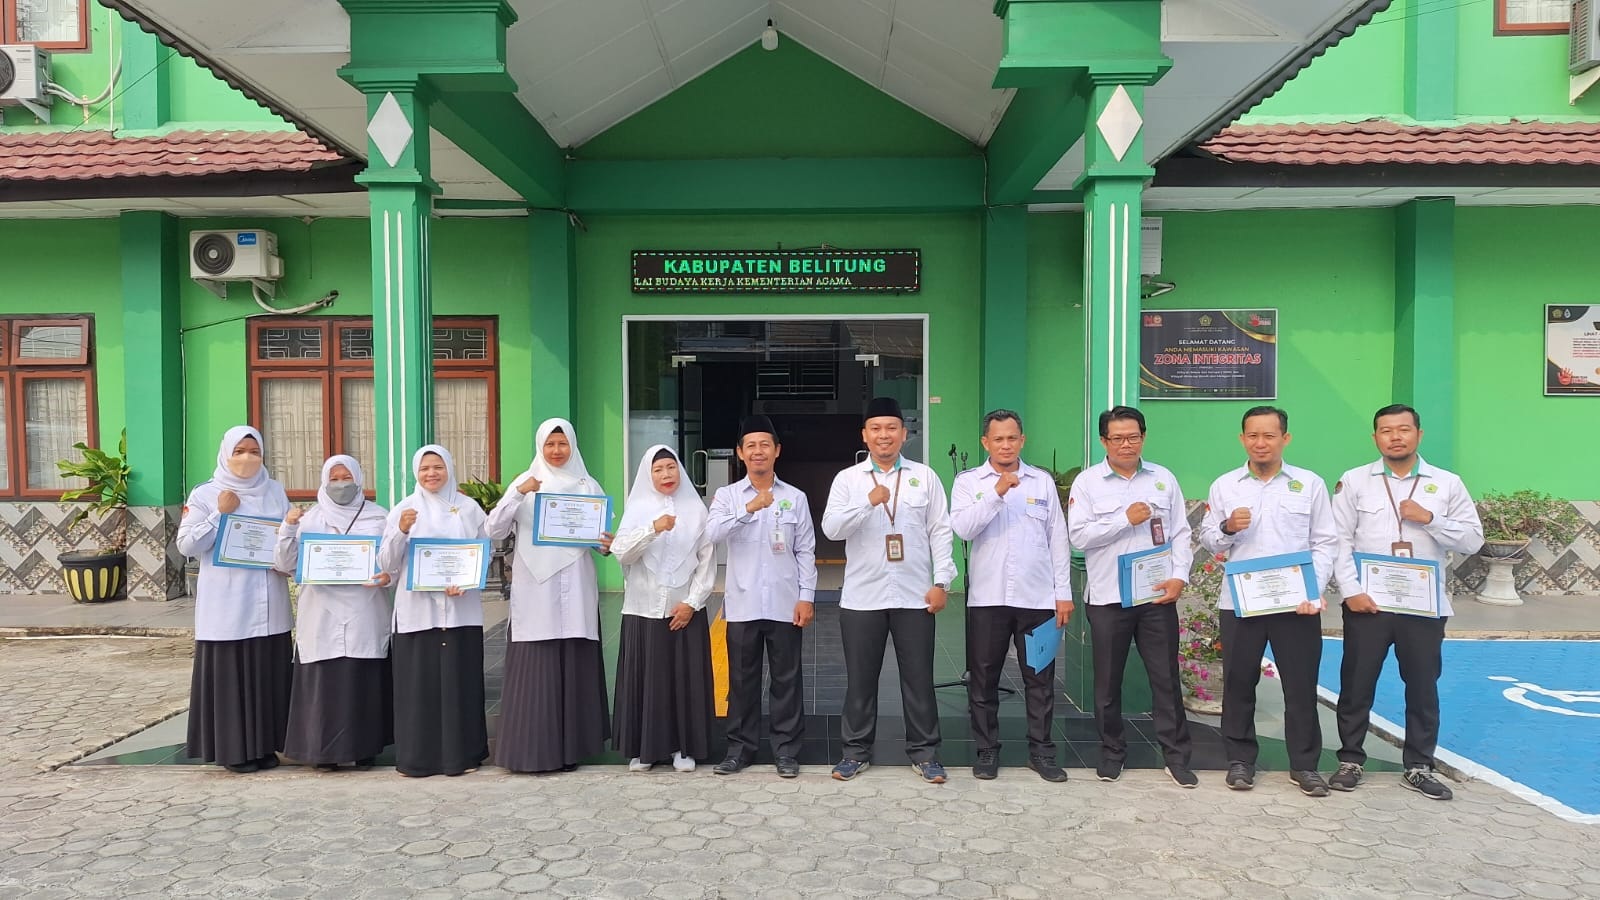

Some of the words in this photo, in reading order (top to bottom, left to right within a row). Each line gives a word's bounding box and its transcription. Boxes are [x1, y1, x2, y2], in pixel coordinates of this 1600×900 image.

[664, 259, 782, 274] KABUPATEN
[789, 259, 886, 273] BELITUNG
[655, 278, 699, 287] BUDAYA
[700, 278, 735, 287] KERJA
[737, 277, 813, 287] KEMENTERIAN
[816, 277, 852, 286] AGAMA
[1154, 353, 1191, 365] ZONA
[1192, 353, 1262, 365] INTEGRITAS
